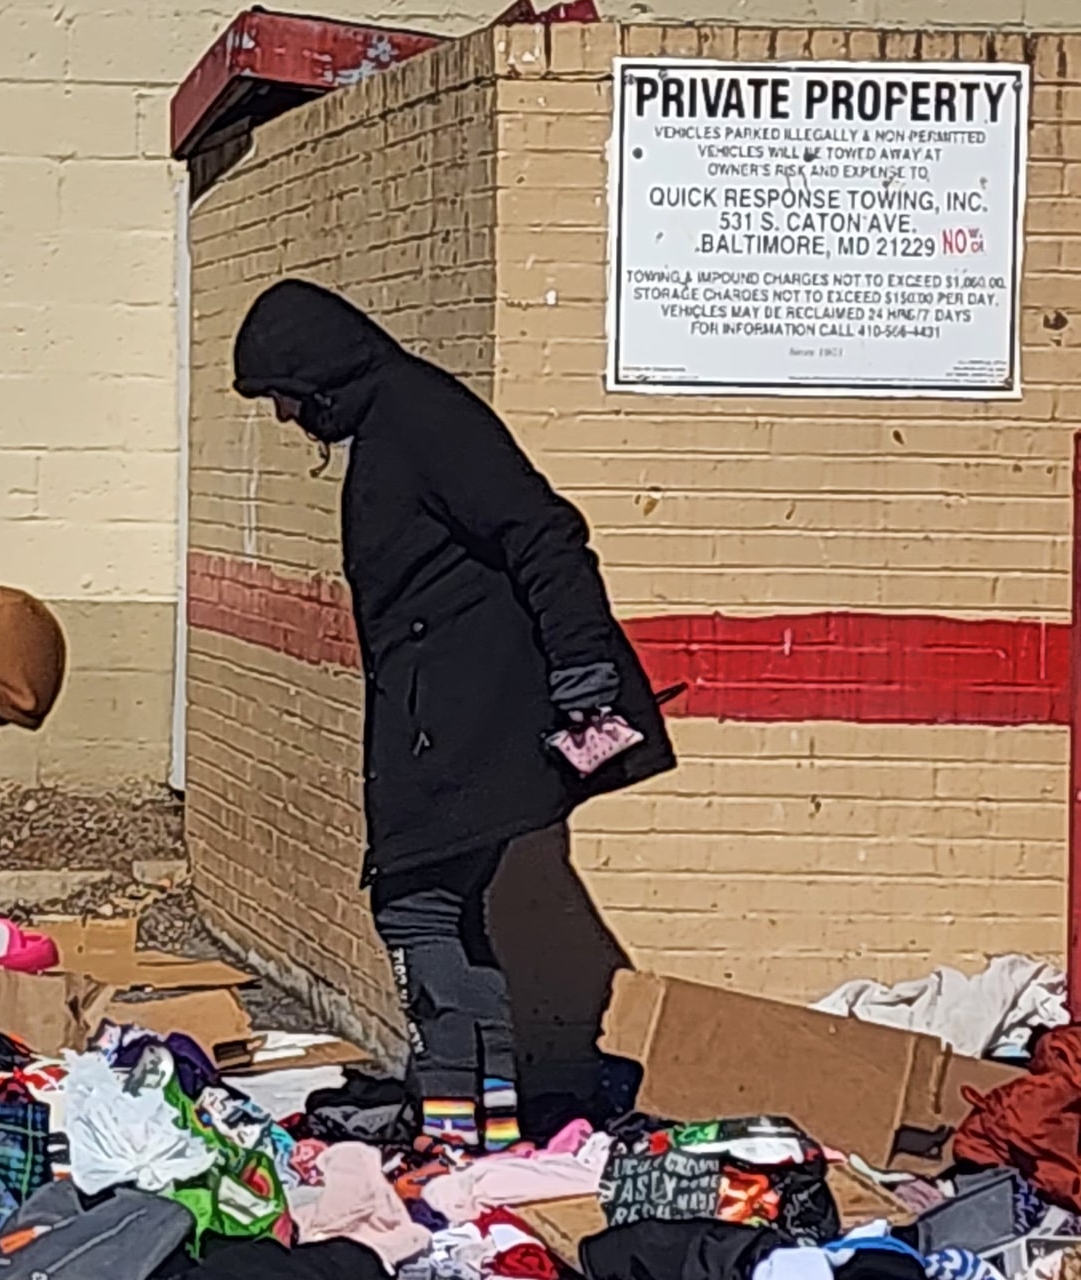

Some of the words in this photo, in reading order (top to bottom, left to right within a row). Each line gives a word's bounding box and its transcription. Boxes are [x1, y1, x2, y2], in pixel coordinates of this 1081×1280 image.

[636, 76, 790, 120] PRIVATE
[805, 80, 1007, 123] PROPERTY
[654, 126, 721, 140] VEHICLES
[725, 127, 780, 141] PARKED
[784, 128, 859, 142] ILLEGALLY
[698, 144, 764, 158] VEHICLES
[769, 146, 799, 159] WILL
[826, 147, 876, 160] TOWED
[880, 148, 921, 161] AWAY
[924, 149, 942, 161] AT
[708, 162, 770, 177] OWNER'S
[774, 164, 806, 177] RISK
[811, 165, 839, 178] AND
[843, 165, 906, 180] EXPENSE
[650, 187, 717, 207] QUICK
[724, 188, 840, 209] RESPONSE
[847, 190, 940, 215] TOWING,
[947, 192, 988, 212] INC.
[719, 212, 751, 231] 531
[760, 212, 780, 231] S.
[787, 212, 860, 233] CATON
[868, 213, 917, 234] AVE.
[701, 233, 831, 258] BALTIMORE,
[838, 236, 869, 256] MD
[876, 236, 935, 257] 21229
[627, 270, 681, 284] TOWING
[698, 271, 759, 285] IMPOUND
[763, 273, 829, 286] CHARGES
[833, 274, 861, 287] NOT
[864, 274, 883, 288] TO
[888, 274, 942, 288] EXCEED
[633, 287, 699, 301] STORAGE
[703, 288, 769, 302] CHARGES
[773, 289, 801, 303] NOT
[805, 290, 823, 303] TO
[827, 290, 881, 304] EXCEED
[937, 292, 963, 306] PER
[968, 293, 1000, 307] DAY.
[661, 305, 727, 319] VEHICLES
[731, 306, 760, 320] MAY
[764, 307, 782, 319] BE
[786, 307, 865, 320] RECLAIMED
[868, 308, 883, 321] 24
[934, 309, 972, 322] DAYS
[691, 322, 719, 335] FOR
[722, 322, 815, 336] INFORMATION
[819, 323, 855, 337] CALL
